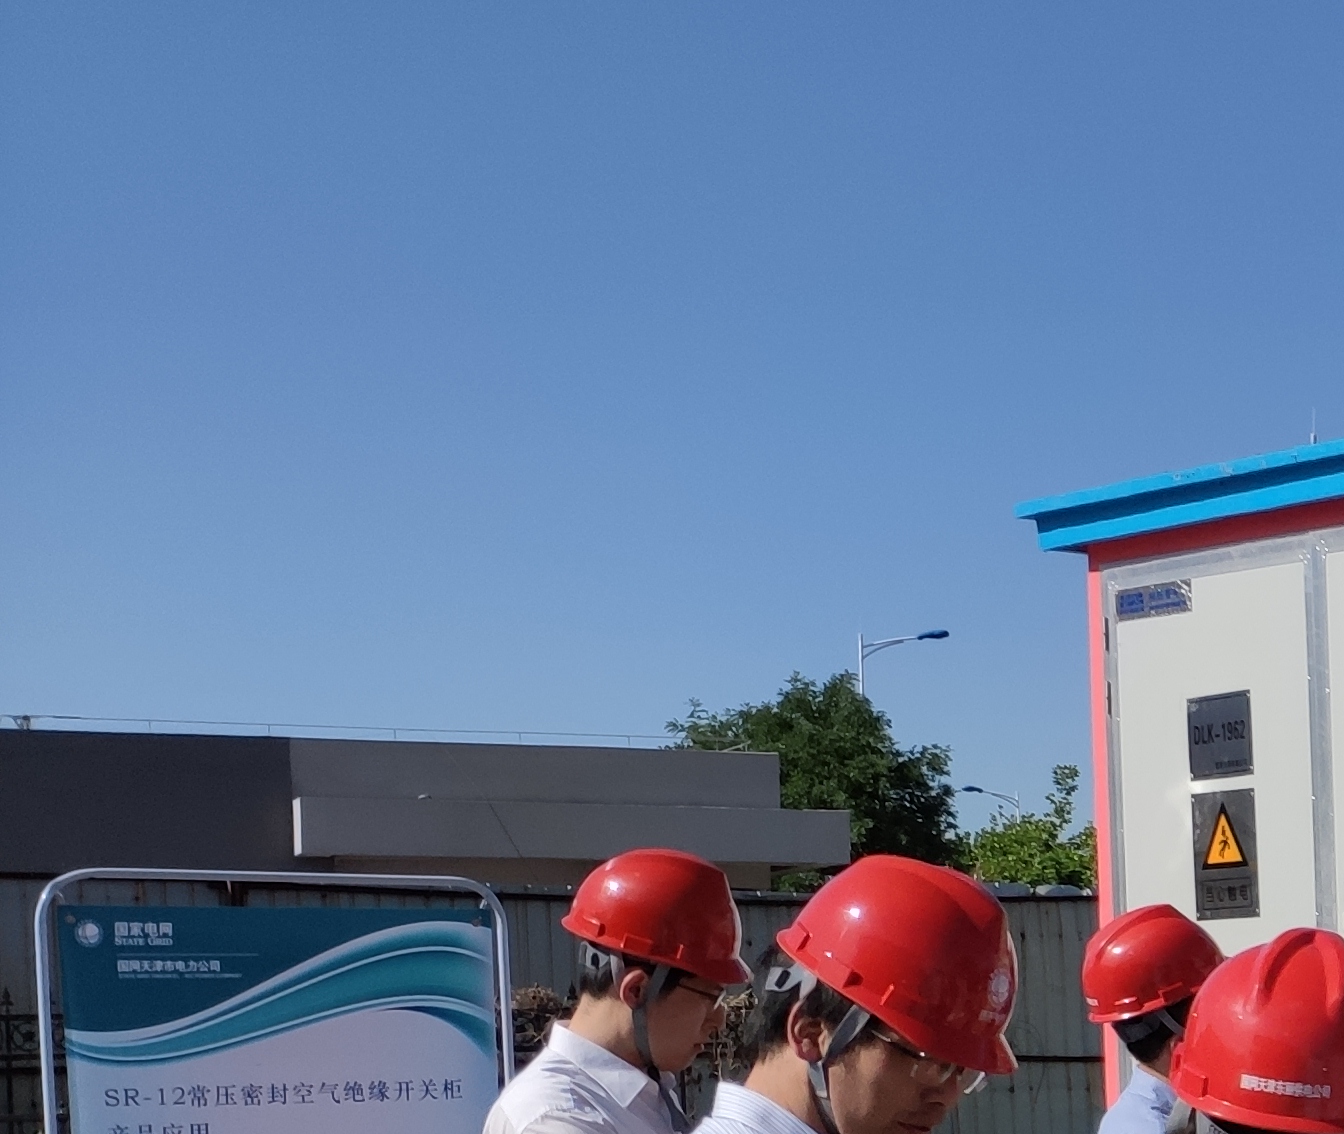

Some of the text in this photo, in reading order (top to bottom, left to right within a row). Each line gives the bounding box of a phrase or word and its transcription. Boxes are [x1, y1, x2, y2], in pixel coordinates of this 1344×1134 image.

[1193, 720, 1246, 746] DLK-1962
[104, 1078, 464, 1108] SR-12常压密封空气绝缘开关柜
